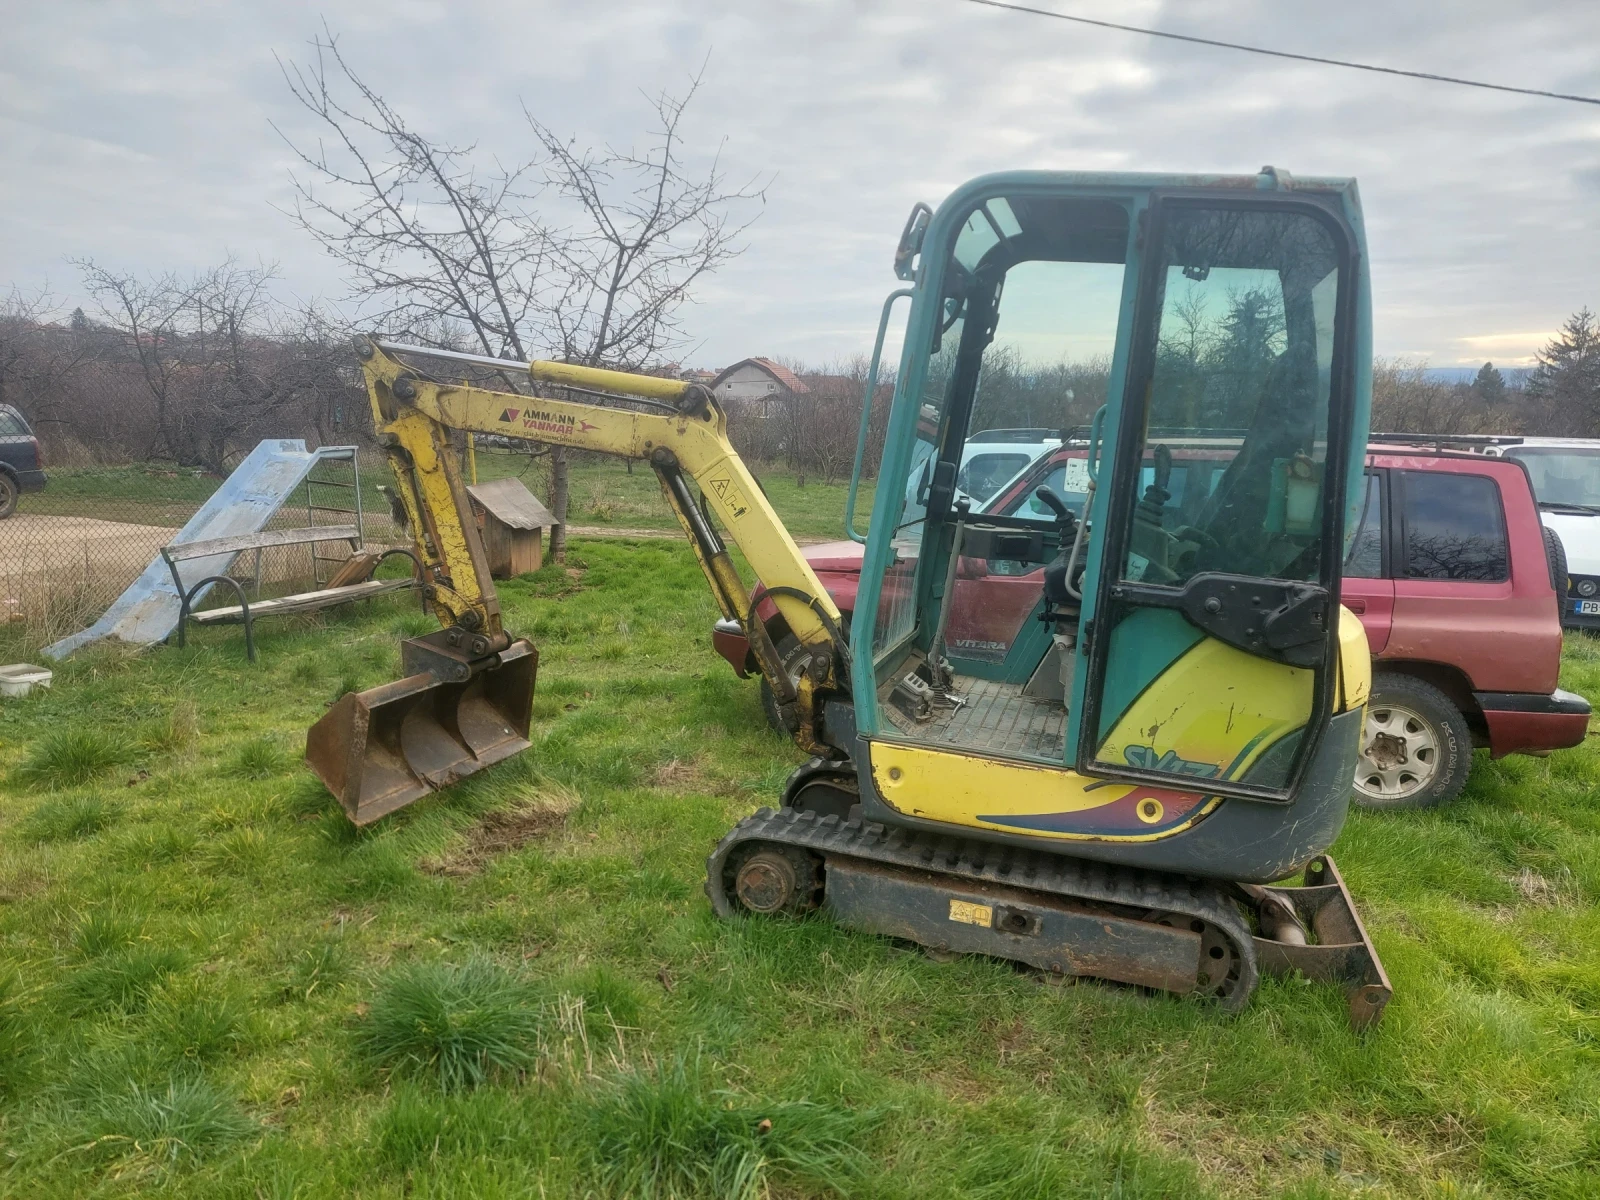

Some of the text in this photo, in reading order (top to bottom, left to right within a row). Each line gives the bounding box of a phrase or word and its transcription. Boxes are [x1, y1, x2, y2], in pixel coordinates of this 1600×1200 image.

[523, 407, 575, 425] AMMANN
[523, 419, 573, 434] YANMAR
[955, 639, 1005, 650] VITARA
[1433, 721, 1457, 796] KUMHO
